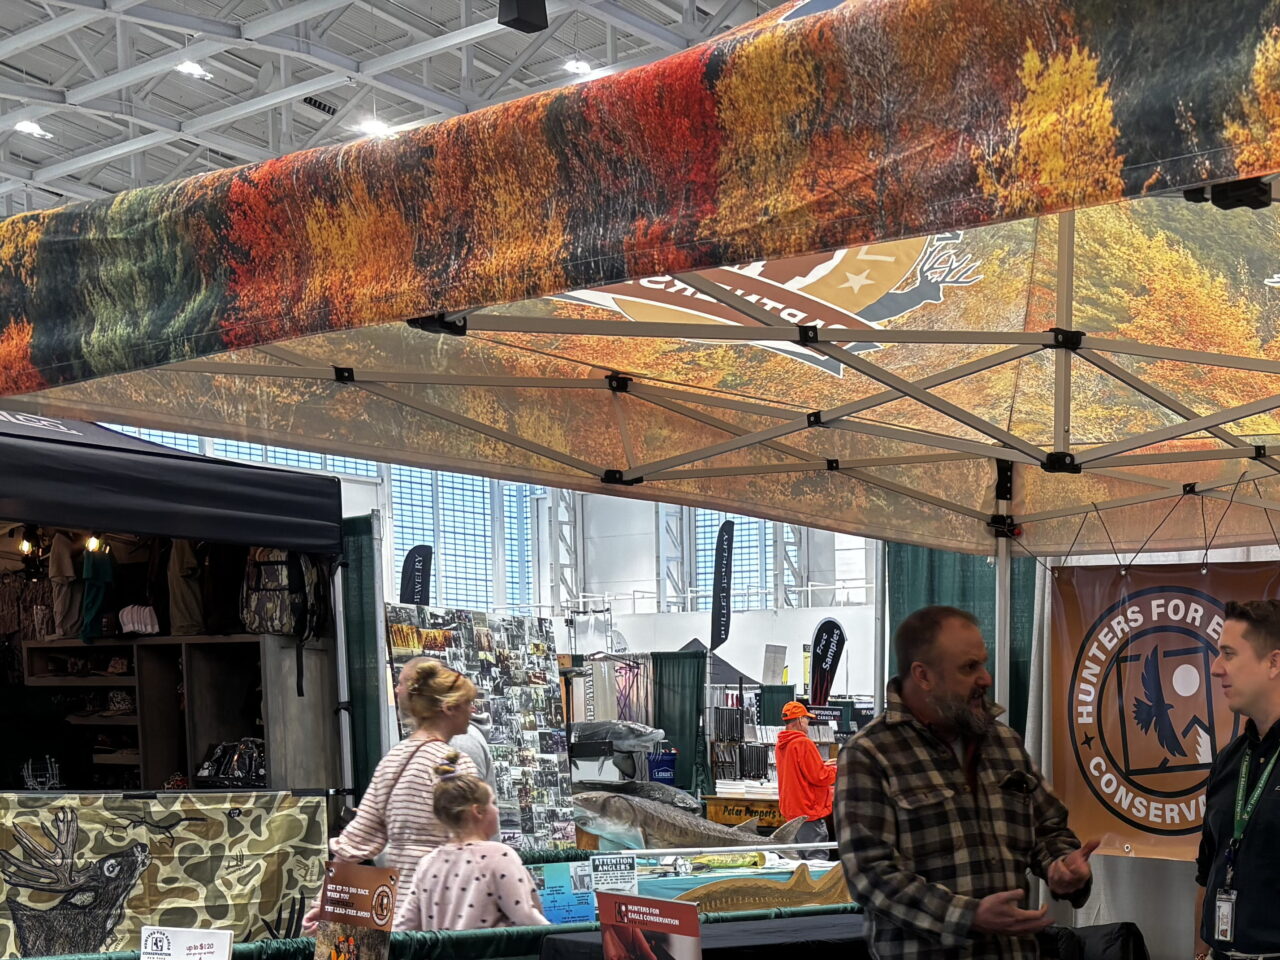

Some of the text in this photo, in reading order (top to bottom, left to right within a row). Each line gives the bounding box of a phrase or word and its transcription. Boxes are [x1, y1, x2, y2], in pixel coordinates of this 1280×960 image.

[817, 632, 828, 655] Free
[823, 629, 840, 670] Samples
[1078, 599, 1203, 724] HUNTERS FOR
[628, 905, 649, 913] HUNTERS
[644, 914, 679, 925] CONSERVATION
